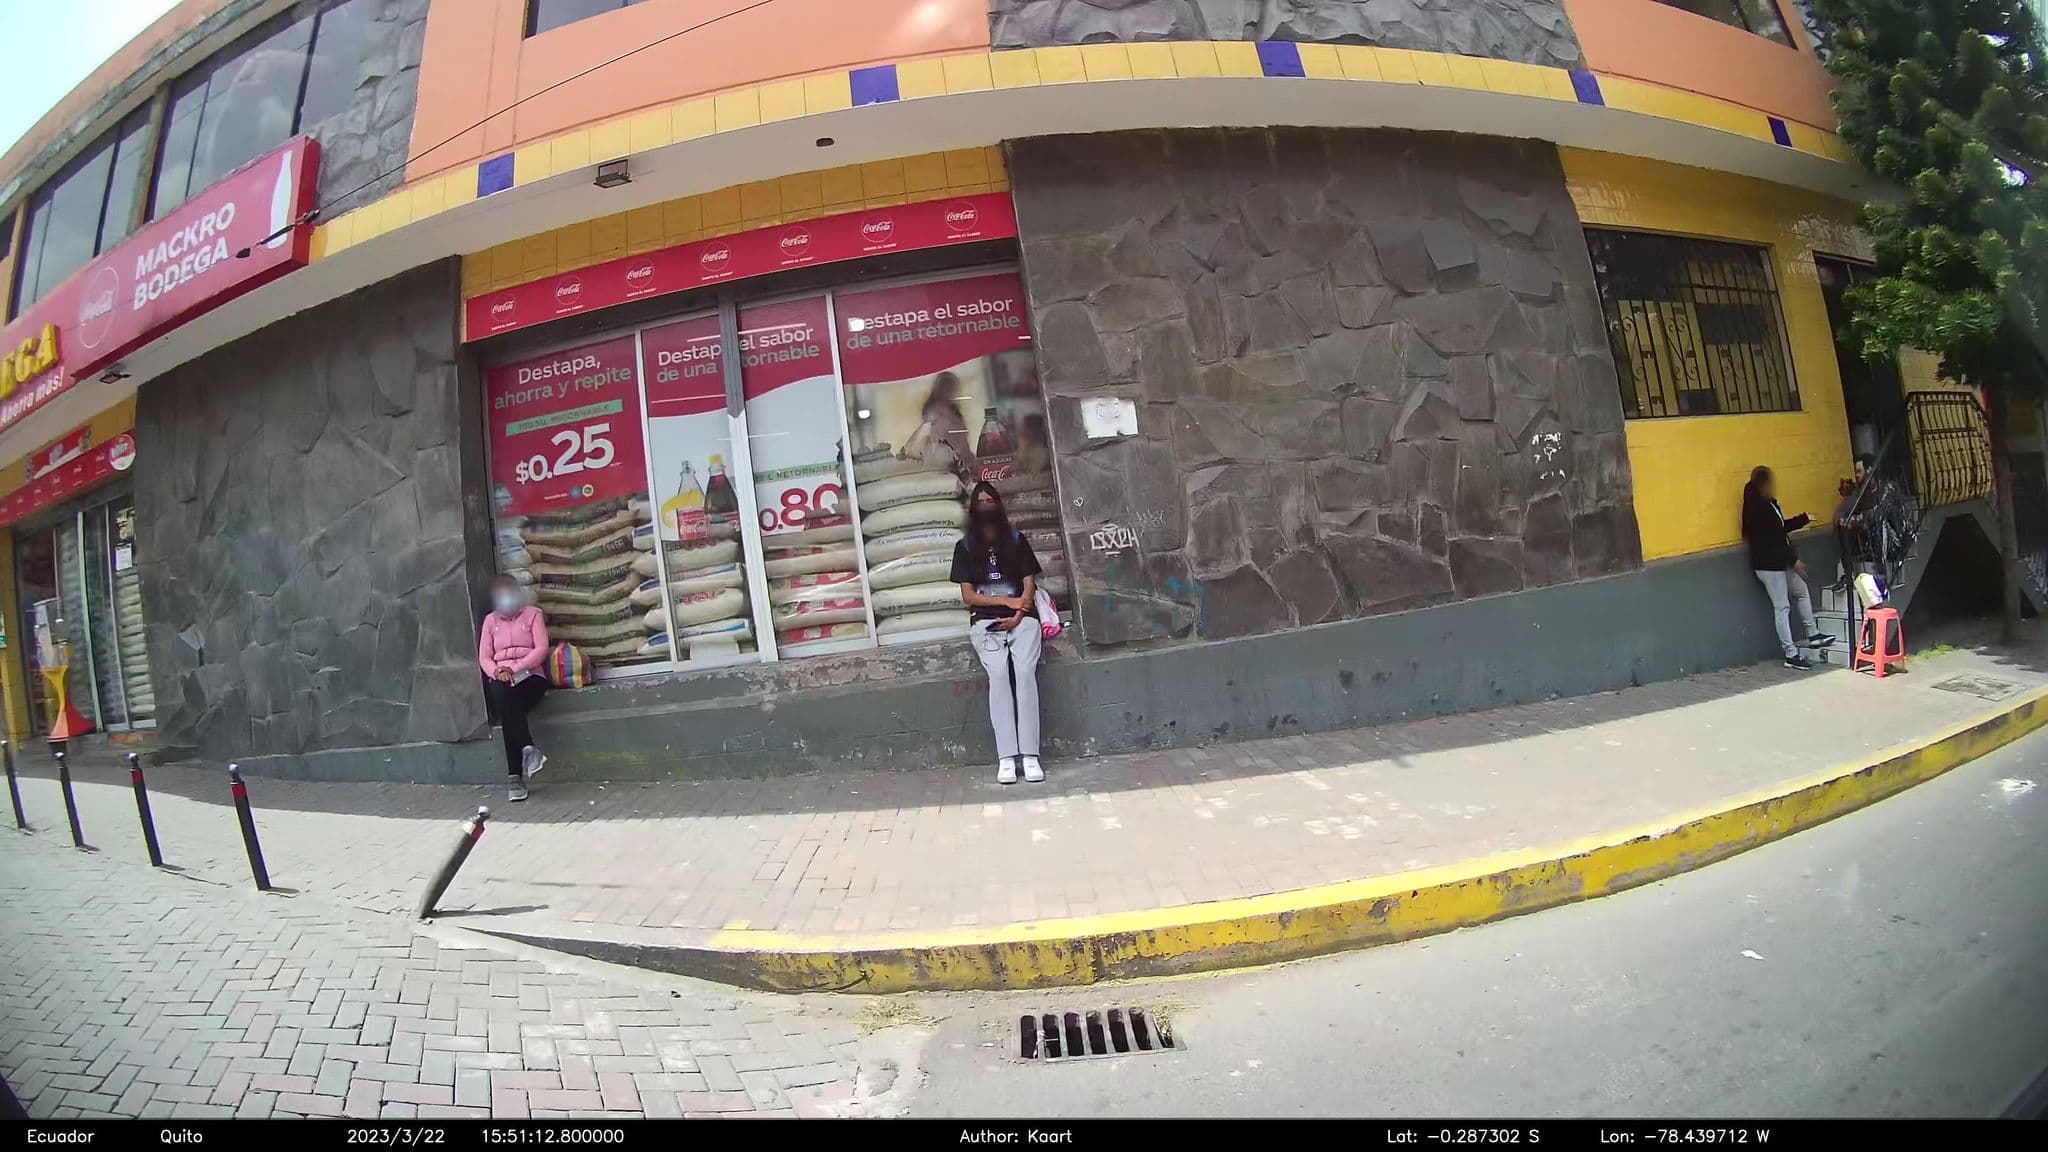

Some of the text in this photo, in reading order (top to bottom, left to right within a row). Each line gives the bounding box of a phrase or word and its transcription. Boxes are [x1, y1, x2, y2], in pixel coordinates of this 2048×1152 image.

[136, 202, 235, 280] MACKRO
[134, 237, 229, 311] BODEGA
[934, 303, 952, 320] el
[957, 298, 1013, 317] sabor
[658, 327, 814, 367] Destap el sabor
[846, 314, 1020, 350] de una retornable
[494, 366, 632, 410] ahorra y repite
[518, 355, 600, 384] Destapa,
[656, 369, 679, 383] de
[684, 361, 718, 378] una
[515, 422, 615, 485] $0.25
